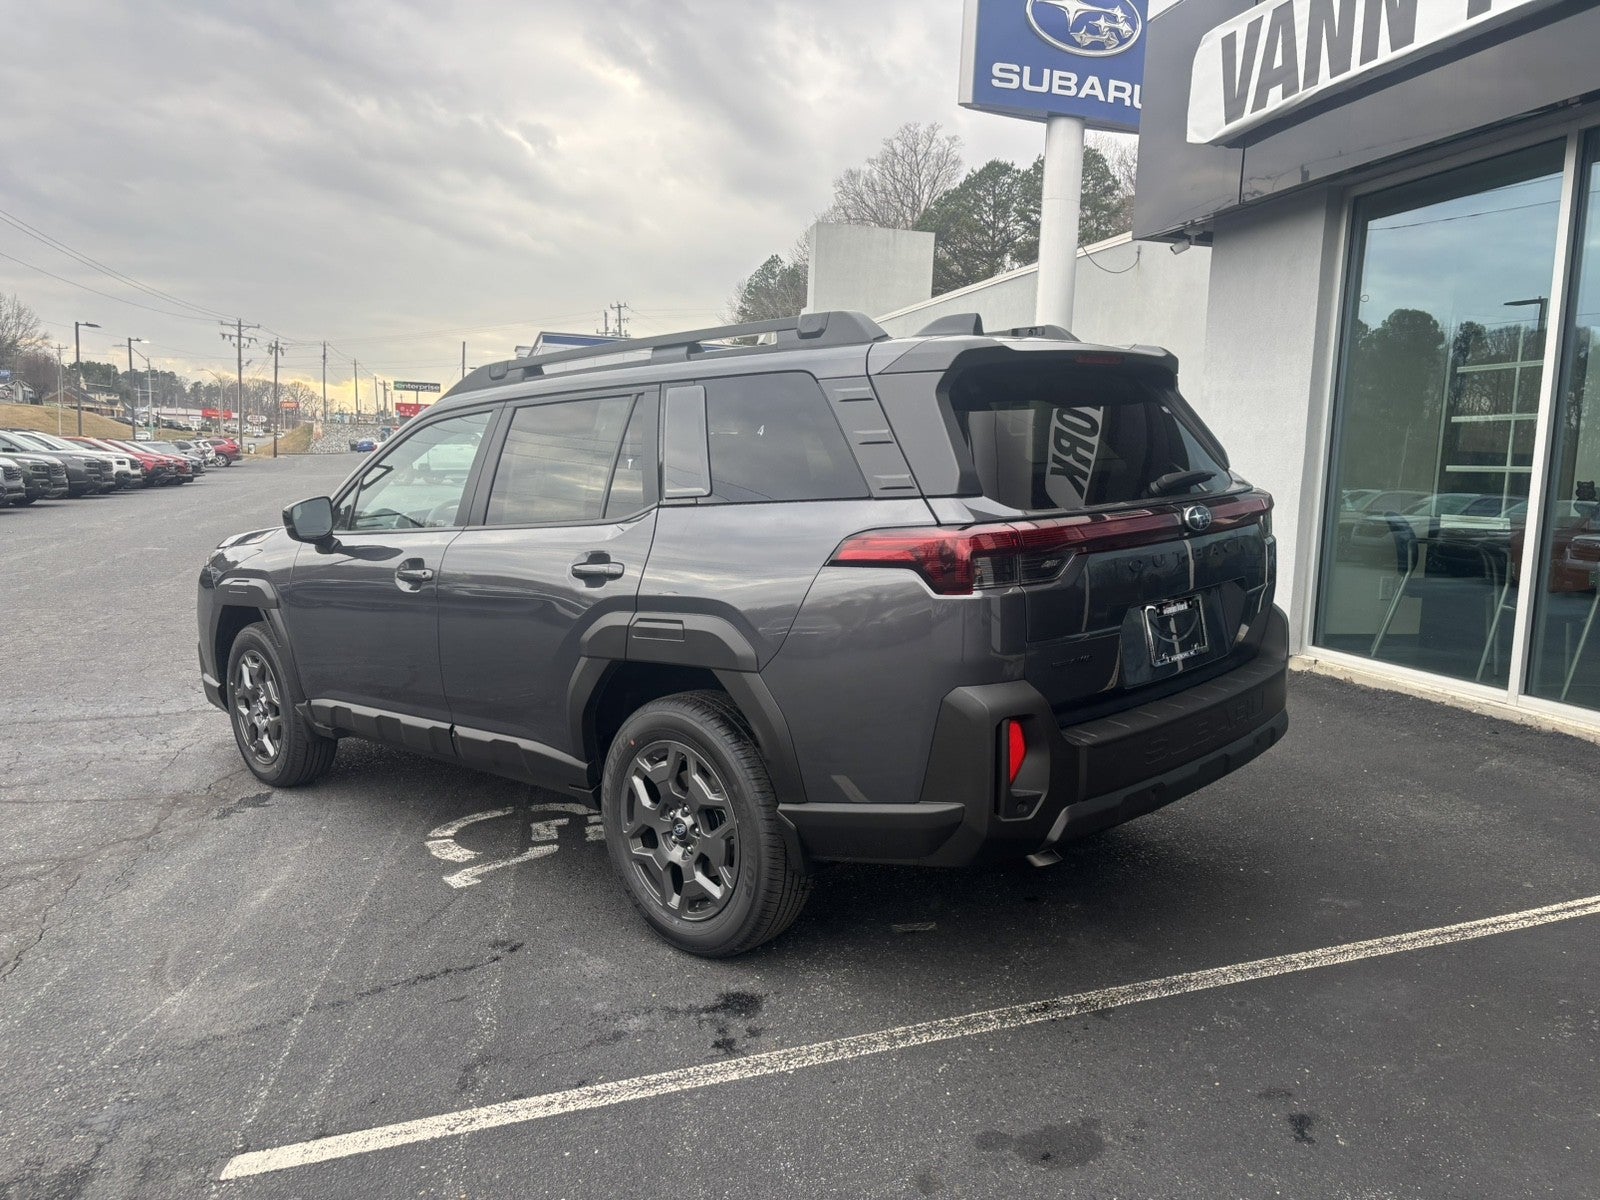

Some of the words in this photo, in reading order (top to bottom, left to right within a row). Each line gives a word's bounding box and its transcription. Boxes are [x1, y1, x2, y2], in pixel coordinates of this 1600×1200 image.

[1221, 0, 1417, 126] VANN
[396, 382, 440, 392] enterprise
[1128, 540, 1248, 573] OUTBACK
